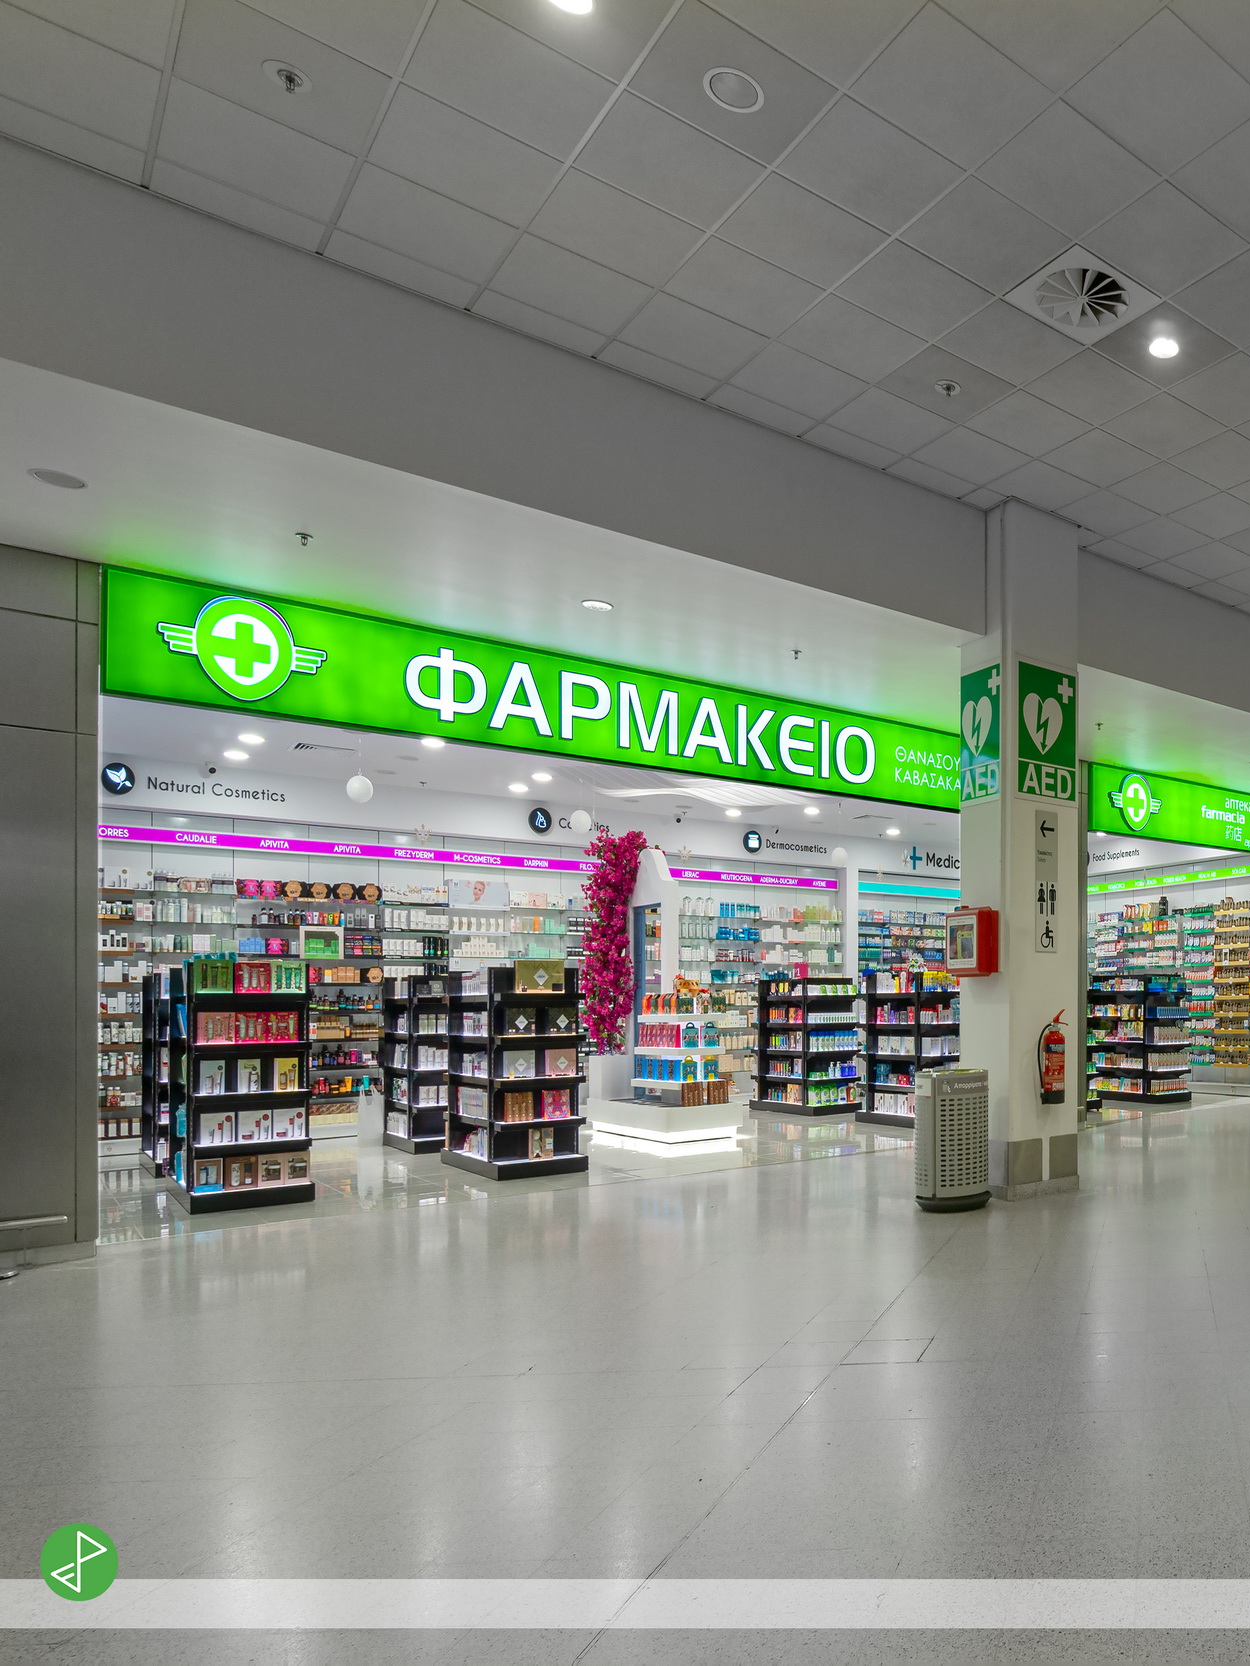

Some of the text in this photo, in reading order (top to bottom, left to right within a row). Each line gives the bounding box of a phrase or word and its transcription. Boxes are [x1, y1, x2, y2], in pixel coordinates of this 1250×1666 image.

[403, 646, 877, 785] ΦΑΡΜΑΚΕΙΟ
[962, 763, 1000, 801] AED
[1022, 763, 1072, 800] AED
[147, 776, 286, 803] Natural Cosmetics
[1201, 805, 1245, 825] farmacia
[175, 833, 217, 844] CAUDALIE
[259, 839, 289, 849] APIVITA
[766, 838, 827, 854] Dermocosmetics
[333, 845, 361, 854] APIVITA
[394, 849, 434, 859] FREZYDERM
[453, 854, 501, 864] M-COSMETICS
[1092, 848, 1140, 862] Food Supplements
[523, 859, 548, 868] DARPHIN
[579, 863, 595, 871] FILO
[682, 870, 699, 879] LIERAC
[720, 873, 753, 883] NEUTROGENA
[759, 876, 798, 886] ADERMA-DUCRAY
